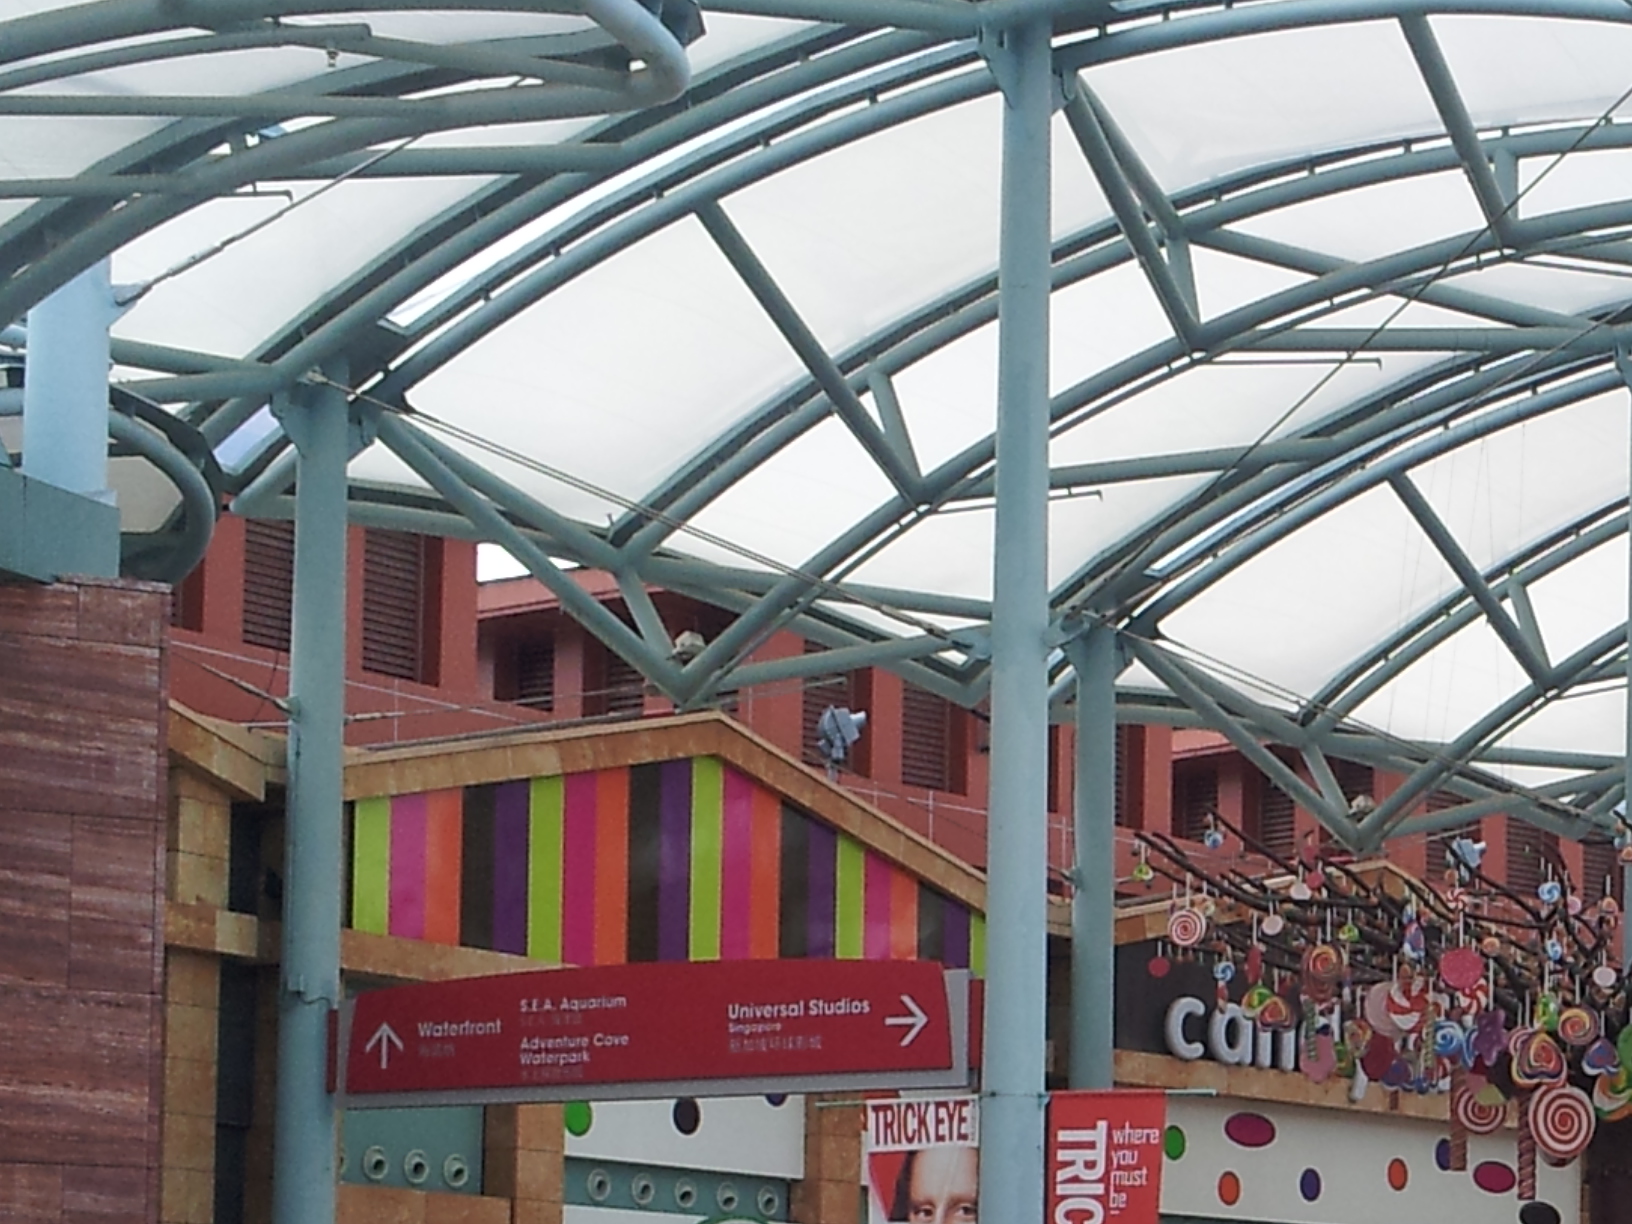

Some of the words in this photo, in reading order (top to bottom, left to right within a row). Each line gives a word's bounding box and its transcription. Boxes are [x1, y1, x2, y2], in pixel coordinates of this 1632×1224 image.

[520, 998, 557, 1013] S.E.A.
[560, 996, 627, 1013] Aquarium
[728, 1001, 804, 1020] Universal
[809, 997, 870, 1016] Studios
[418, 1019, 502, 1038] Waterfront
[520, 1035, 588, 1050] Adventure
[520, 1051, 590, 1066] Waterpark
[871, 1102, 931, 1146] TRICK
[934, 1100, 970, 1143] EYE
[1112, 1121, 1159, 1144] where
[1111, 1150, 1138, 1169] you
[1110, 1166, 1148, 1188] must
